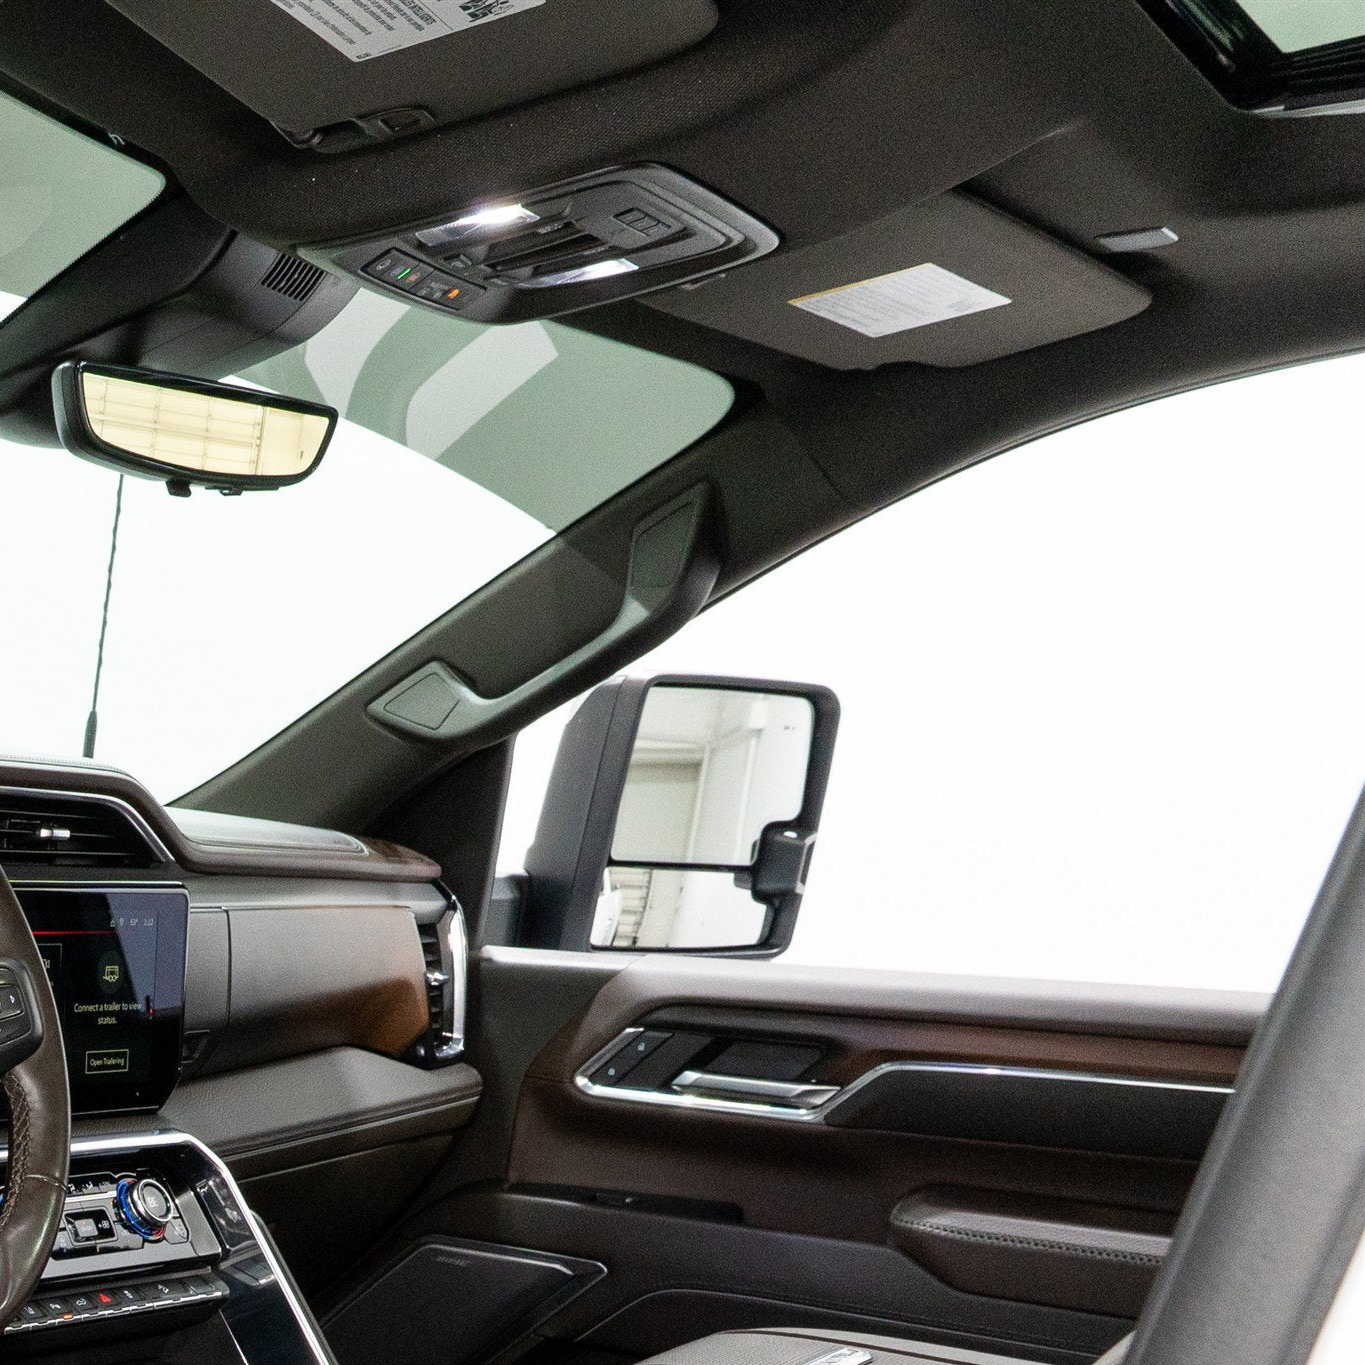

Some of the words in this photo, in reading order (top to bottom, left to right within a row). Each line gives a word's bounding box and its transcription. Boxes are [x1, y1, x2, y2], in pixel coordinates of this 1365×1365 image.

[73, 1003, 98, 1013] Connect
[104, 1001, 121, 1011] trailer
[122, 1002, 128, 1010] to
[129, 1002, 143, 1010] view
